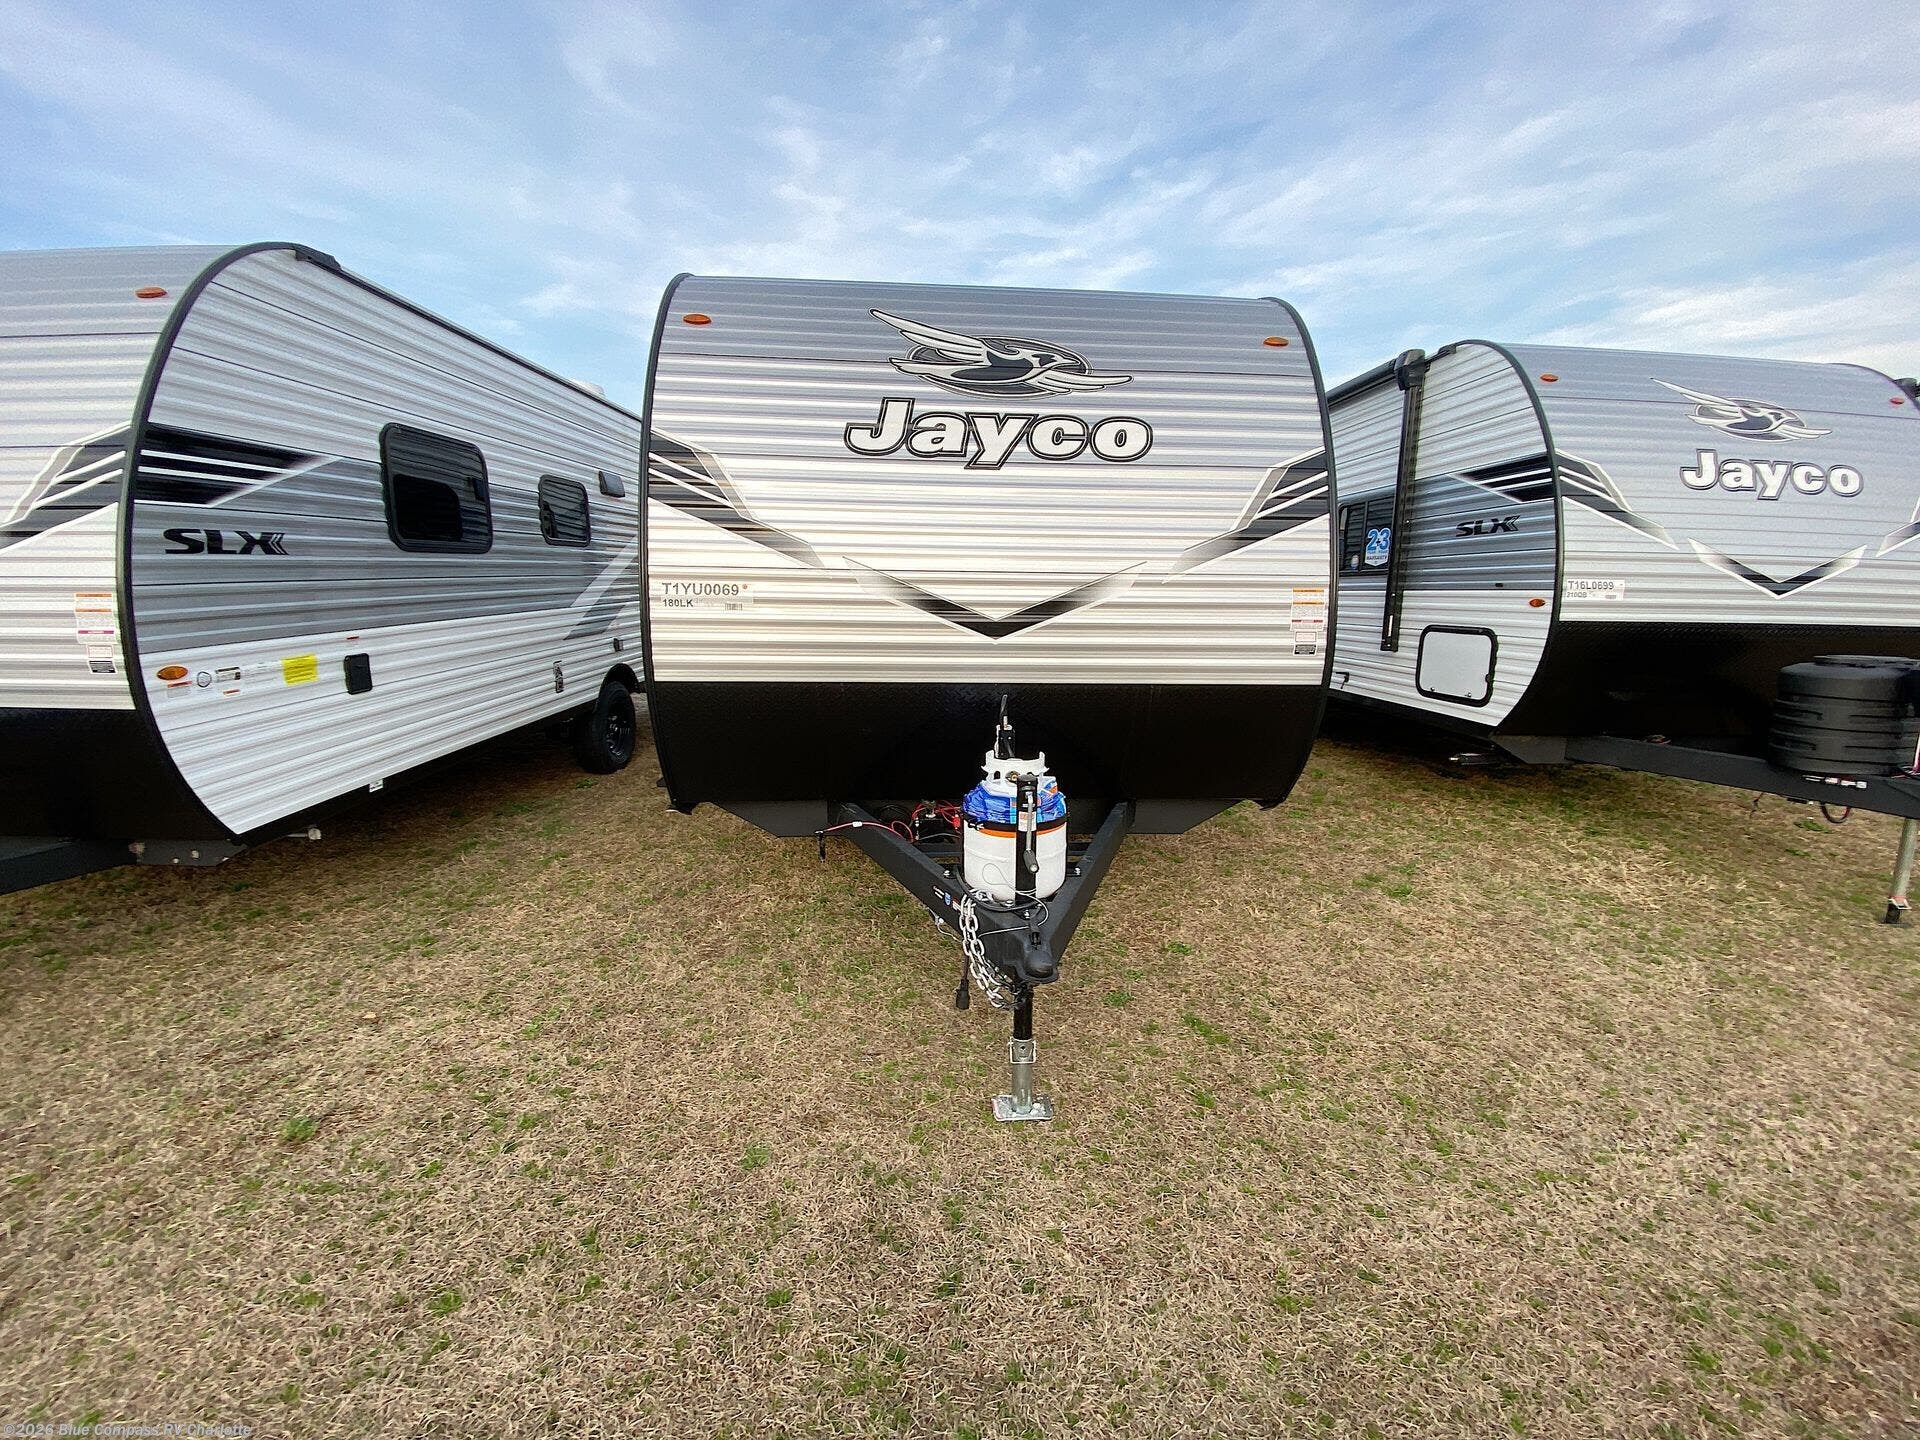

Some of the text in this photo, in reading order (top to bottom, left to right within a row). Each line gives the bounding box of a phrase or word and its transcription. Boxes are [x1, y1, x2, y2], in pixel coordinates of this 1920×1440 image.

[843, 396, 1154, 470] Jayco
[1679, 448, 1864, 501] Jayco
[1455, 514, 1521, 537] SLX
[163, 528, 290, 556] SLX
[661, 582, 739, 596] T1YU0069
[662, 598, 694, 607] 180LK
